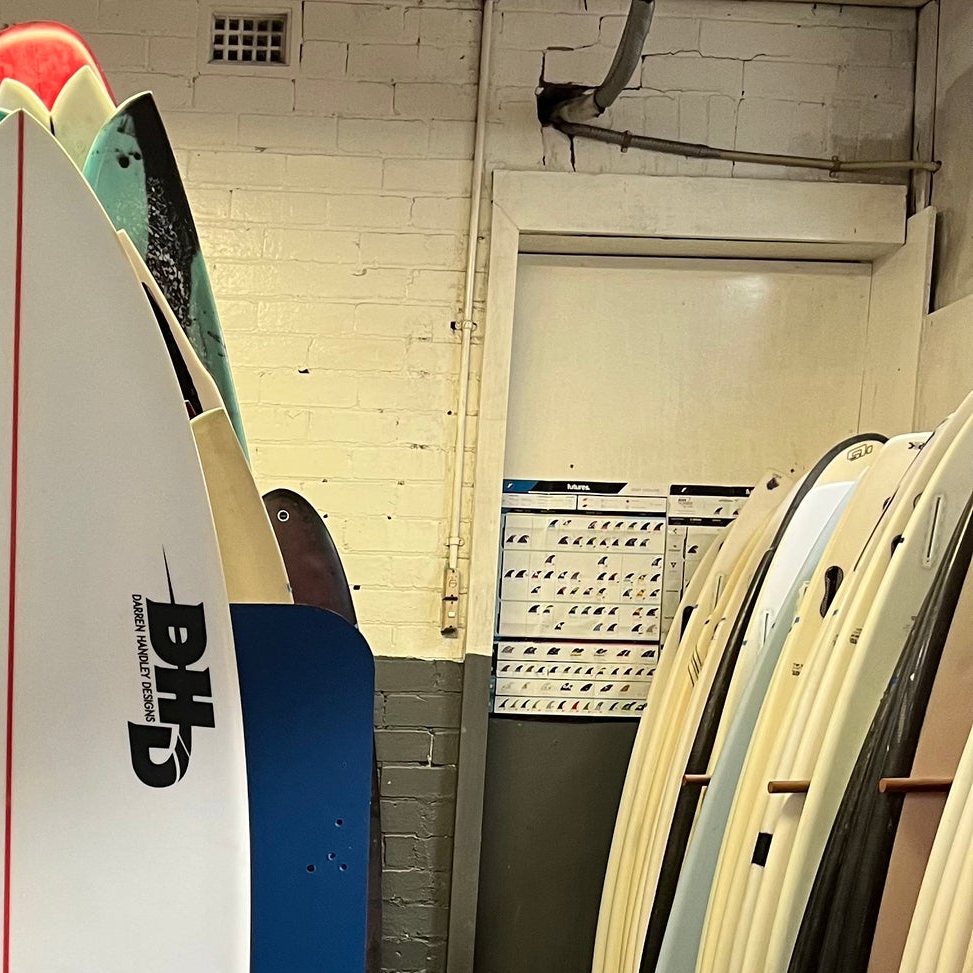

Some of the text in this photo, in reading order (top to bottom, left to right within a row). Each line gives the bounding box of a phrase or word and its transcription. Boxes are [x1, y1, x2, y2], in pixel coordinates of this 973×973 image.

[127, 544, 215, 788] DHD
[132, 594, 156, 722] DARREN HANDLEY DESIGNS
